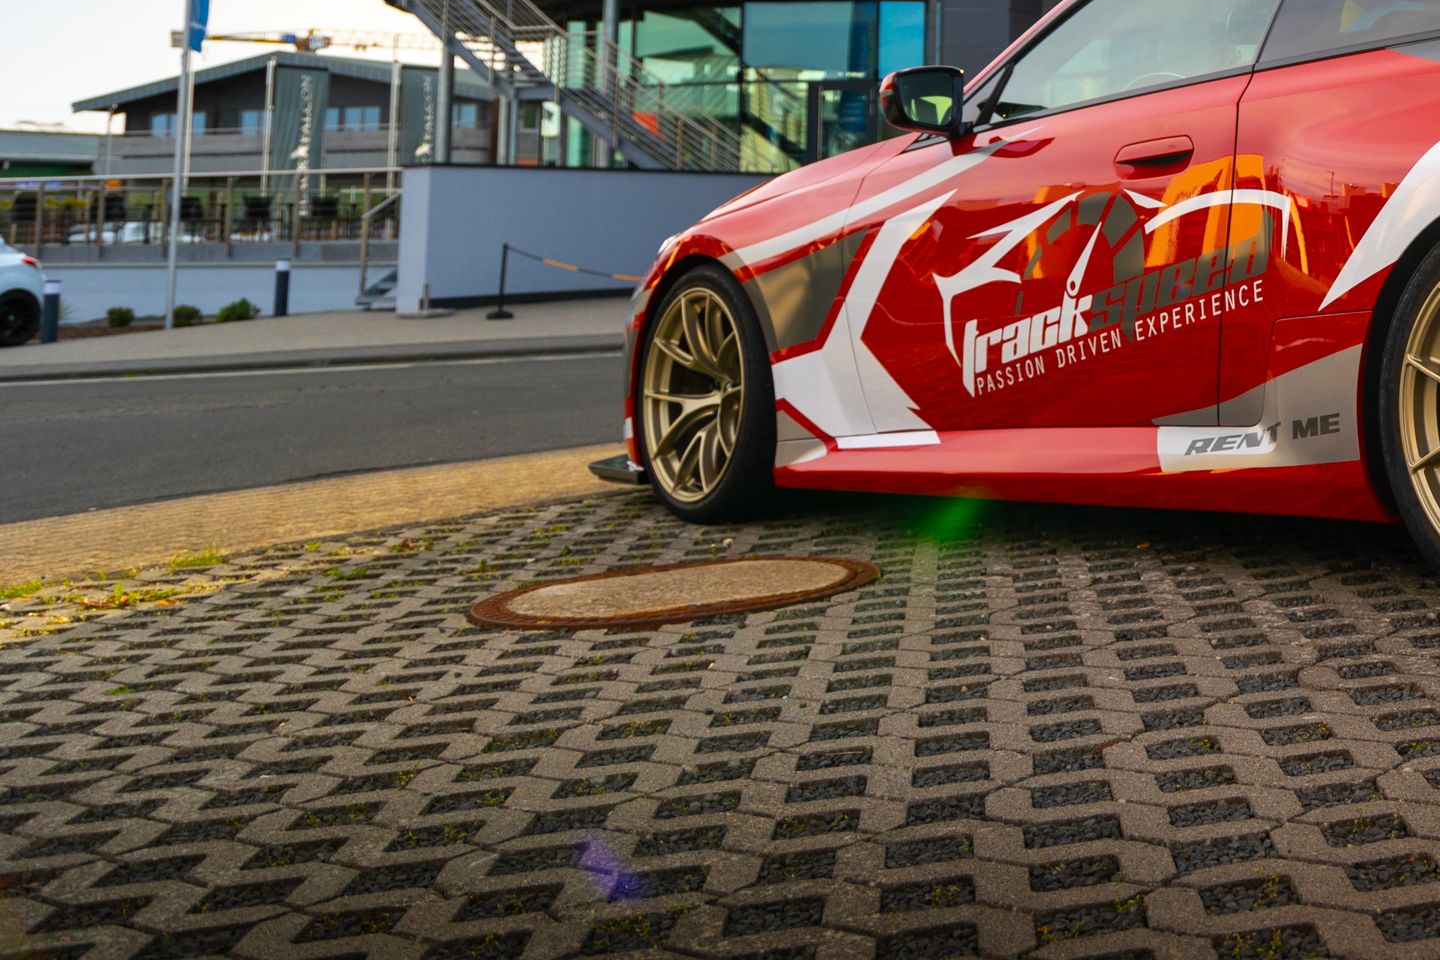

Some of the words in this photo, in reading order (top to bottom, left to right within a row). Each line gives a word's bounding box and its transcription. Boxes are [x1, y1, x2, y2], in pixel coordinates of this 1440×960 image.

[977, 356, 1045, 395] PASSION
[1056, 328, 1121, 368] DRIVEN
[1134, 280, 1264, 341] EXPERIENCE
[1184, 421, 1282, 456] RENT
[1292, 413, 1341, 440] ME
